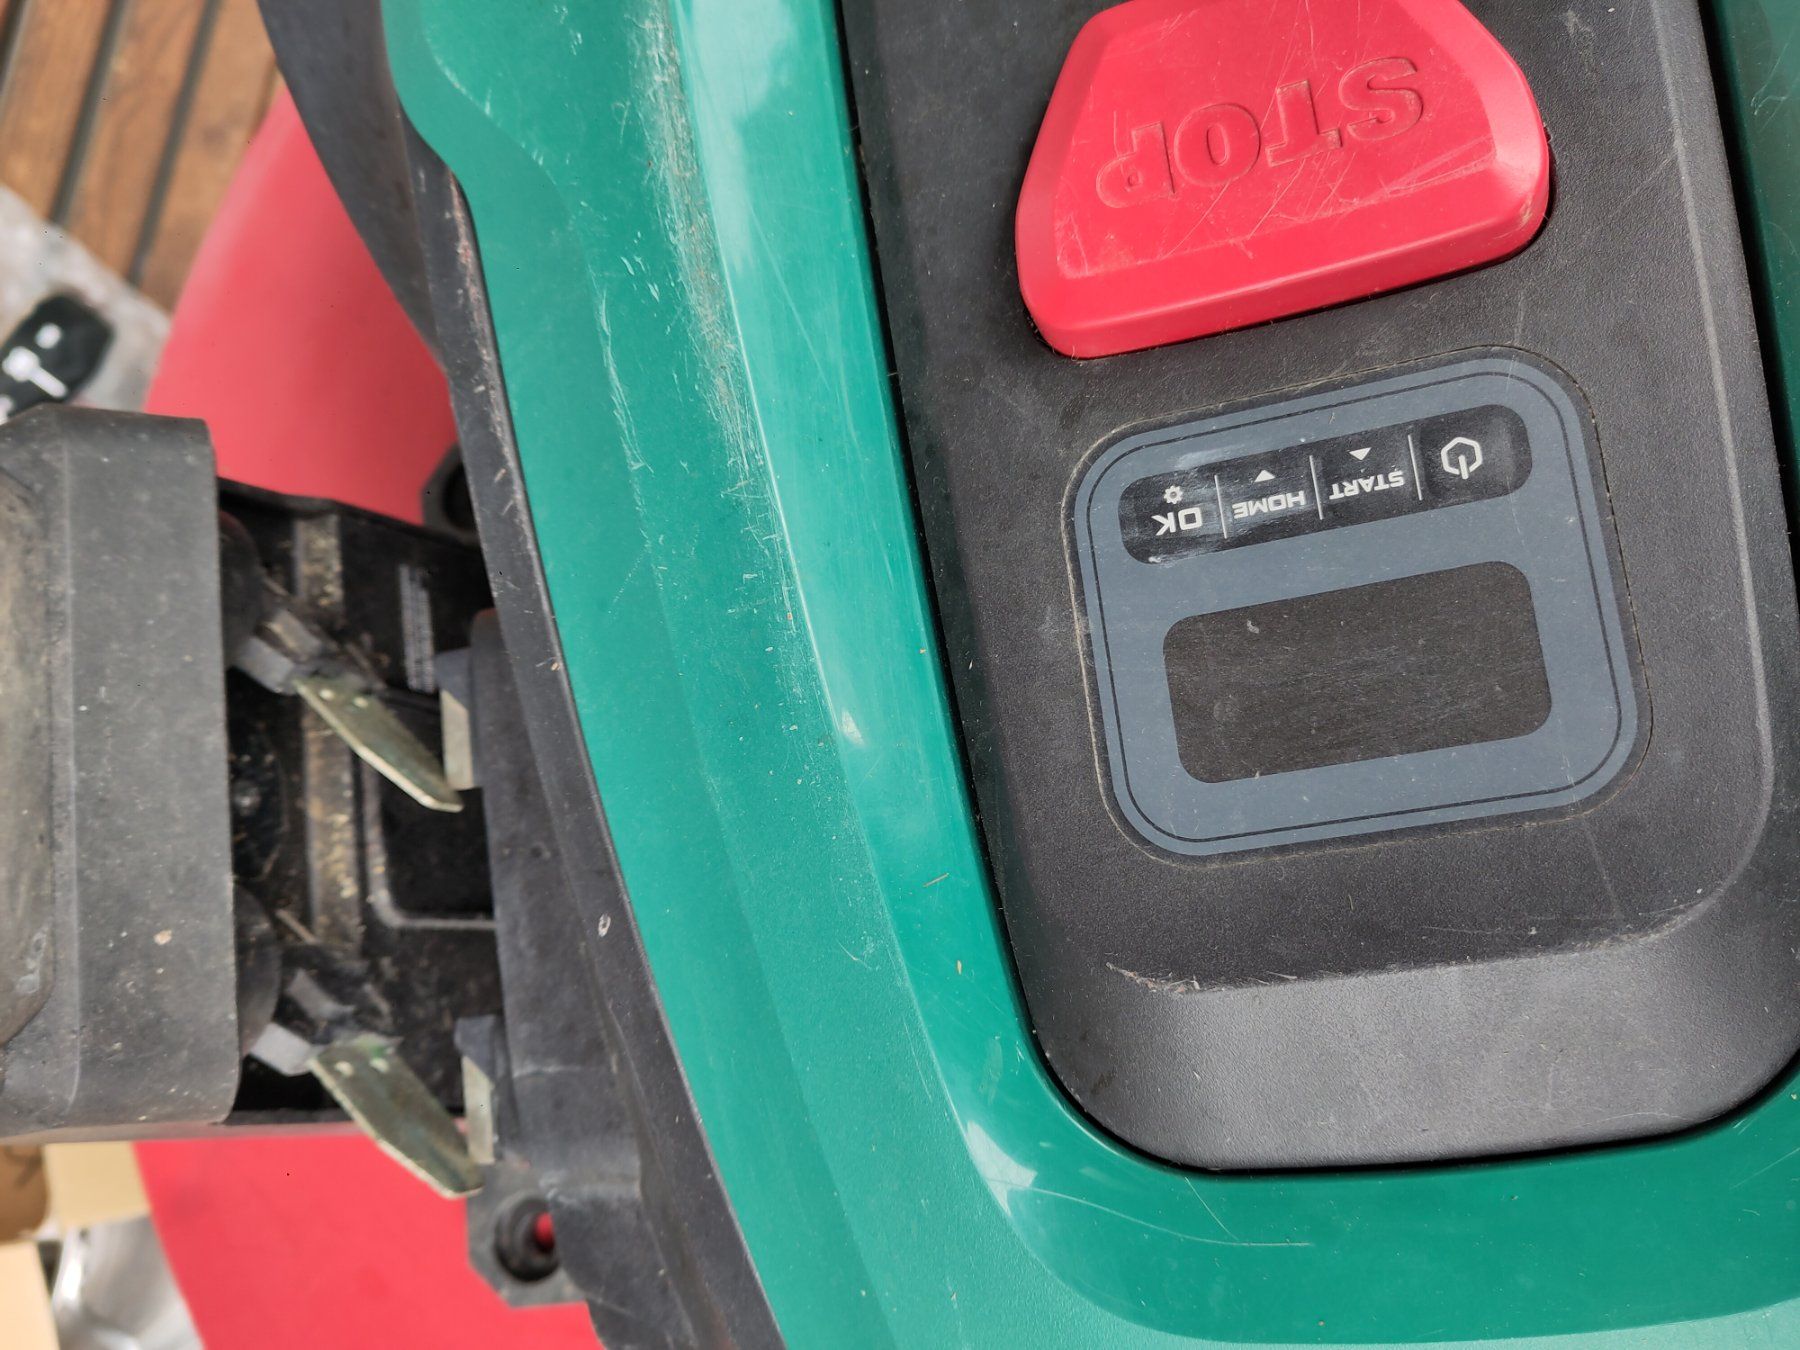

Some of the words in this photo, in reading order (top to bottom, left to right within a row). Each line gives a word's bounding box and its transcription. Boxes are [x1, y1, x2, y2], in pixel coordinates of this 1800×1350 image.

[1096, 57, 1424, 208] STOP
[1329, 470, 1406, 500] START
[1233, 489, 1307, 520] HOME
[1151, 506, 1203, 536] OK
